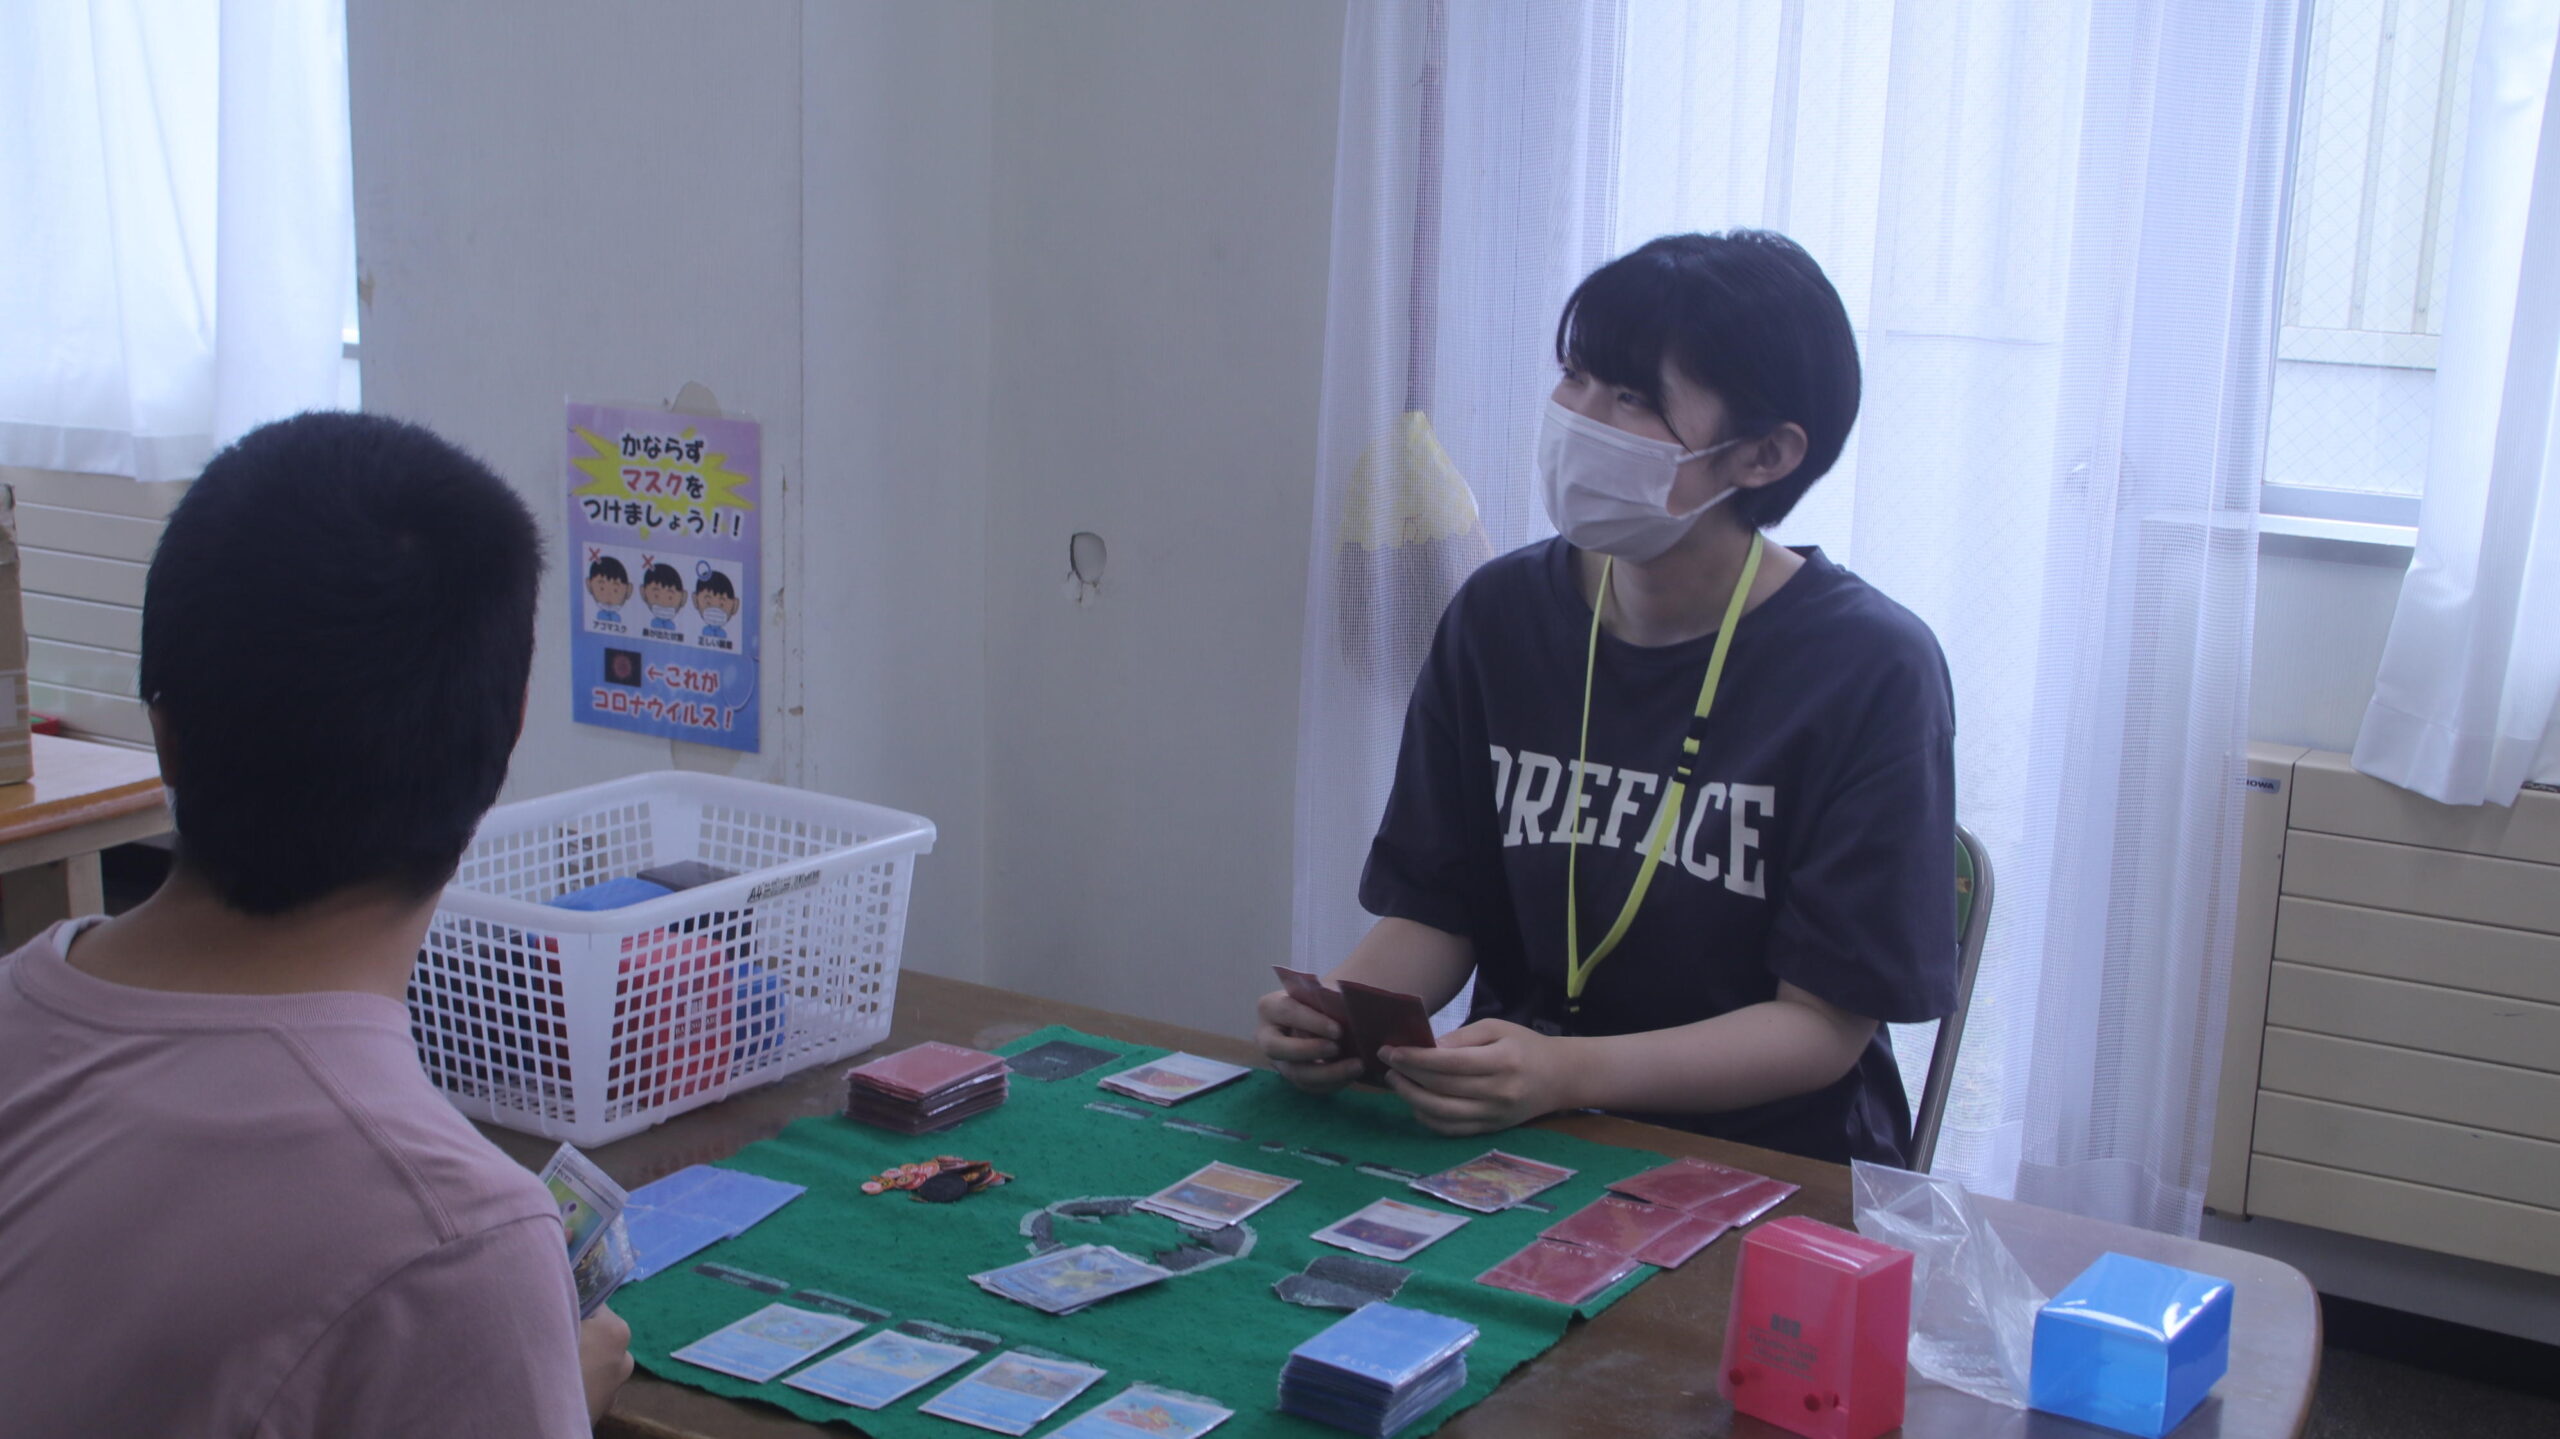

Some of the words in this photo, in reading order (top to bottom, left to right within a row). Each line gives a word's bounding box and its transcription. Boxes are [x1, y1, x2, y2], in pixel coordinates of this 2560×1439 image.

[621, 432, 705, 464] かならず
[622, 468, 704, 499] マスクを
[583, 498, 741, 537] つけましょう！！
[665, 666, 719, 693] これが
[594, 690, 733, 729] コロナウイルス！
